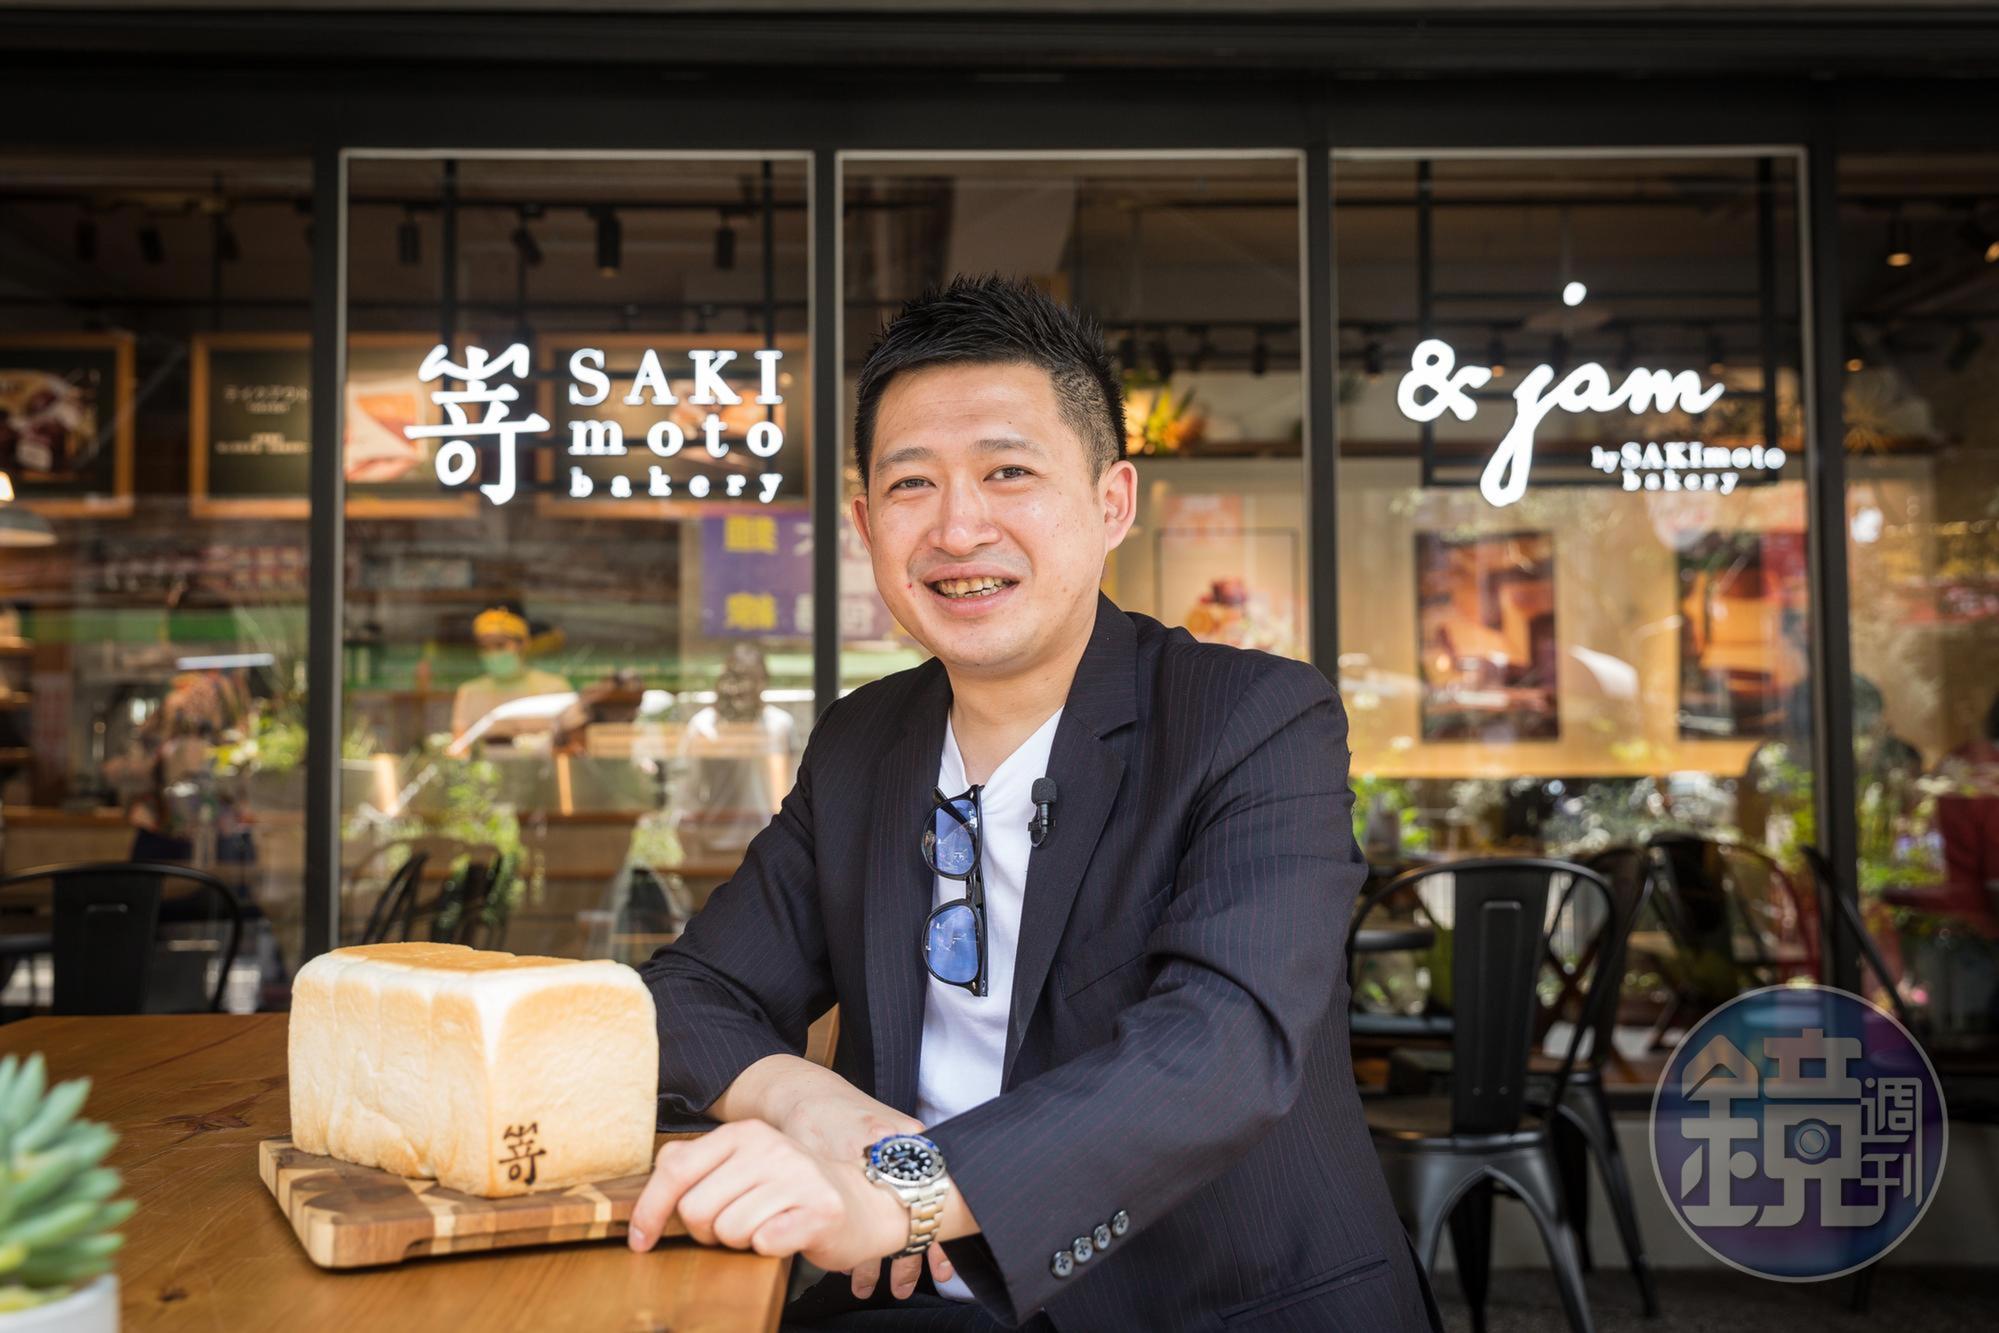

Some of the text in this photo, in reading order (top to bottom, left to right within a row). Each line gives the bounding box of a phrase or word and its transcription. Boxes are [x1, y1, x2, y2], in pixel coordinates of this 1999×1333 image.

[569, 348, 784, 406] SAKI
[1397, 281, 1725, 508] & jam
[568, 413, 784, 459] moto
[1591, 445, 1621, 473] by
[569, 465, 783, 503] bakery
[1622, 468, 1740, 496] bakery
